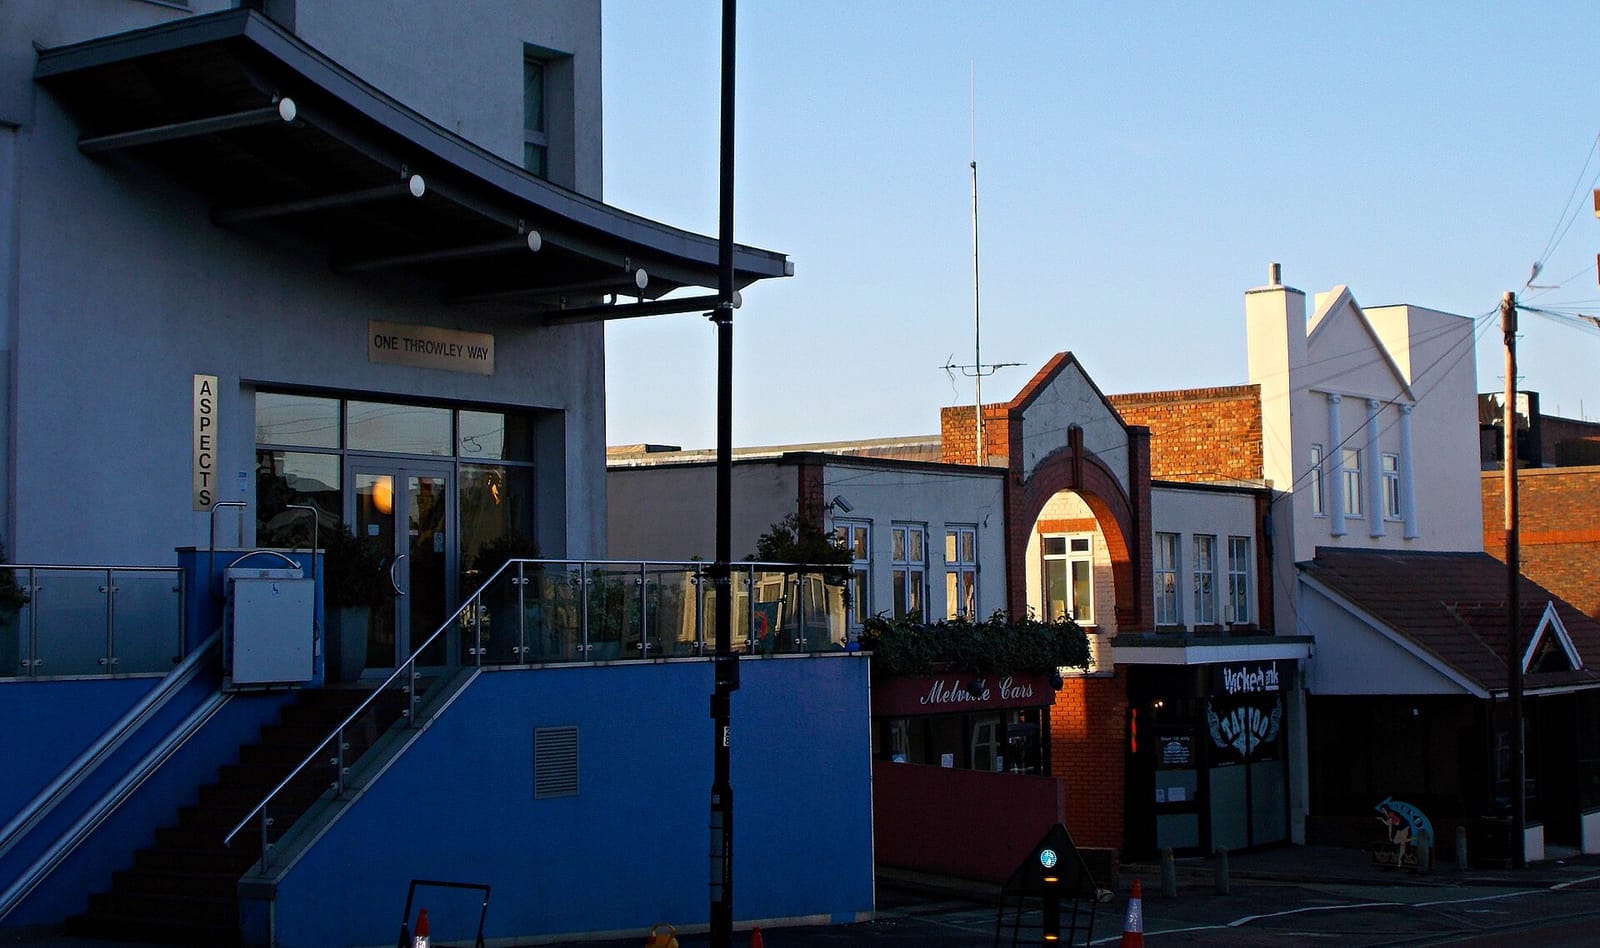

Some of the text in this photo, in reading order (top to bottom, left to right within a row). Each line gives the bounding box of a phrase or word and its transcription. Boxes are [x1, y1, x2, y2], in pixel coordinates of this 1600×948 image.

[374, 334, 489, 361] ONE THROWLEY WAY
[199, 380, 212, 506] ASPECTS
[920, 676, 1033, 704] Melvile Cars
[1220, 706, 1269, 740] TATTOO
